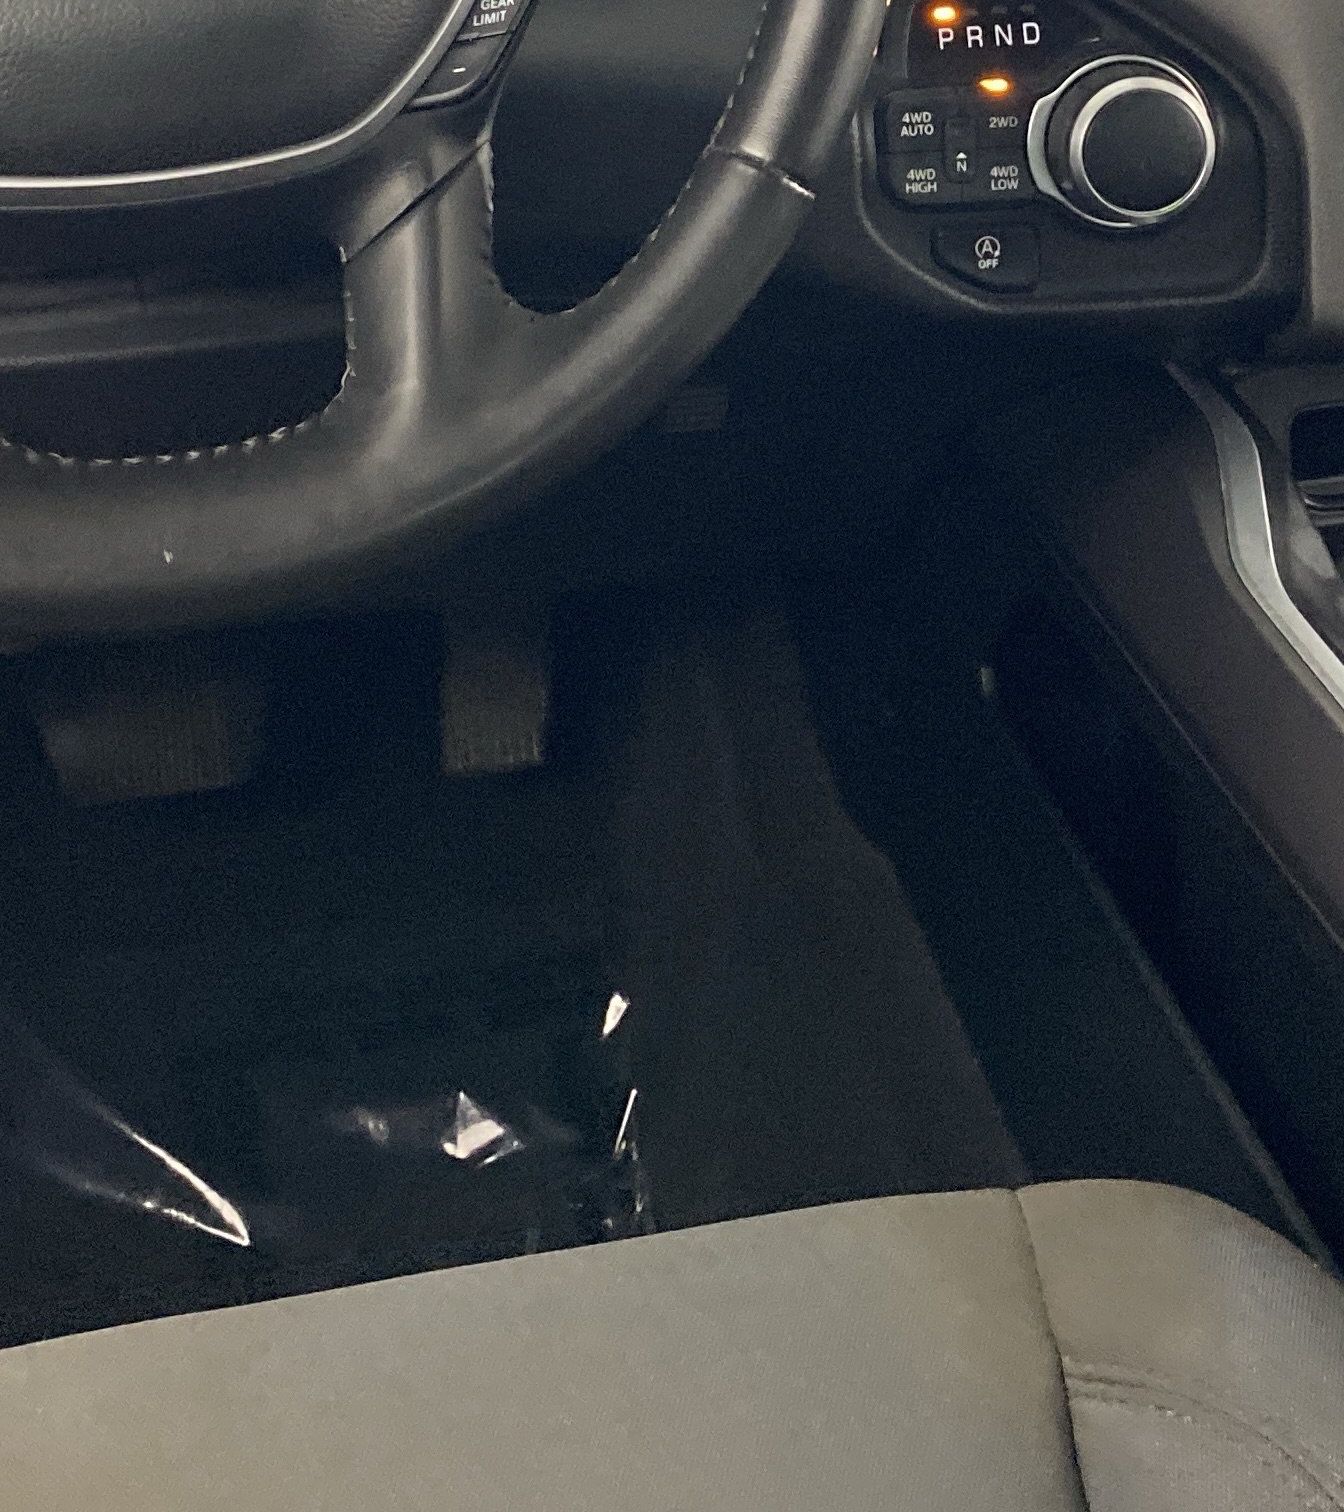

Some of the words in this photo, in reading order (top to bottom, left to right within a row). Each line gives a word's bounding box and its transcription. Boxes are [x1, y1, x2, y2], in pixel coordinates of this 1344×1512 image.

[472, 9, 508, 27] LIMIT
[937, 27, 955, 51] P
[966, 25, 984, 49] R
[994, 23, 1014, 47] N
[1021, 21, 1041, 46] D
[901, 111, 933, 124] 4WD
[988, 116, 1019, 129] 2WD
[900, 123, 935, 137] AUTO
[956, 160, 968, 173] N
[990, 165, 1019, 178] 4WD
[906, 168, 937, 181] 4WD
[905, 181, 938, 195] HIGH
[990, 177, 1020, 192] LOW
[977, 257, 1000, 271] OFF
